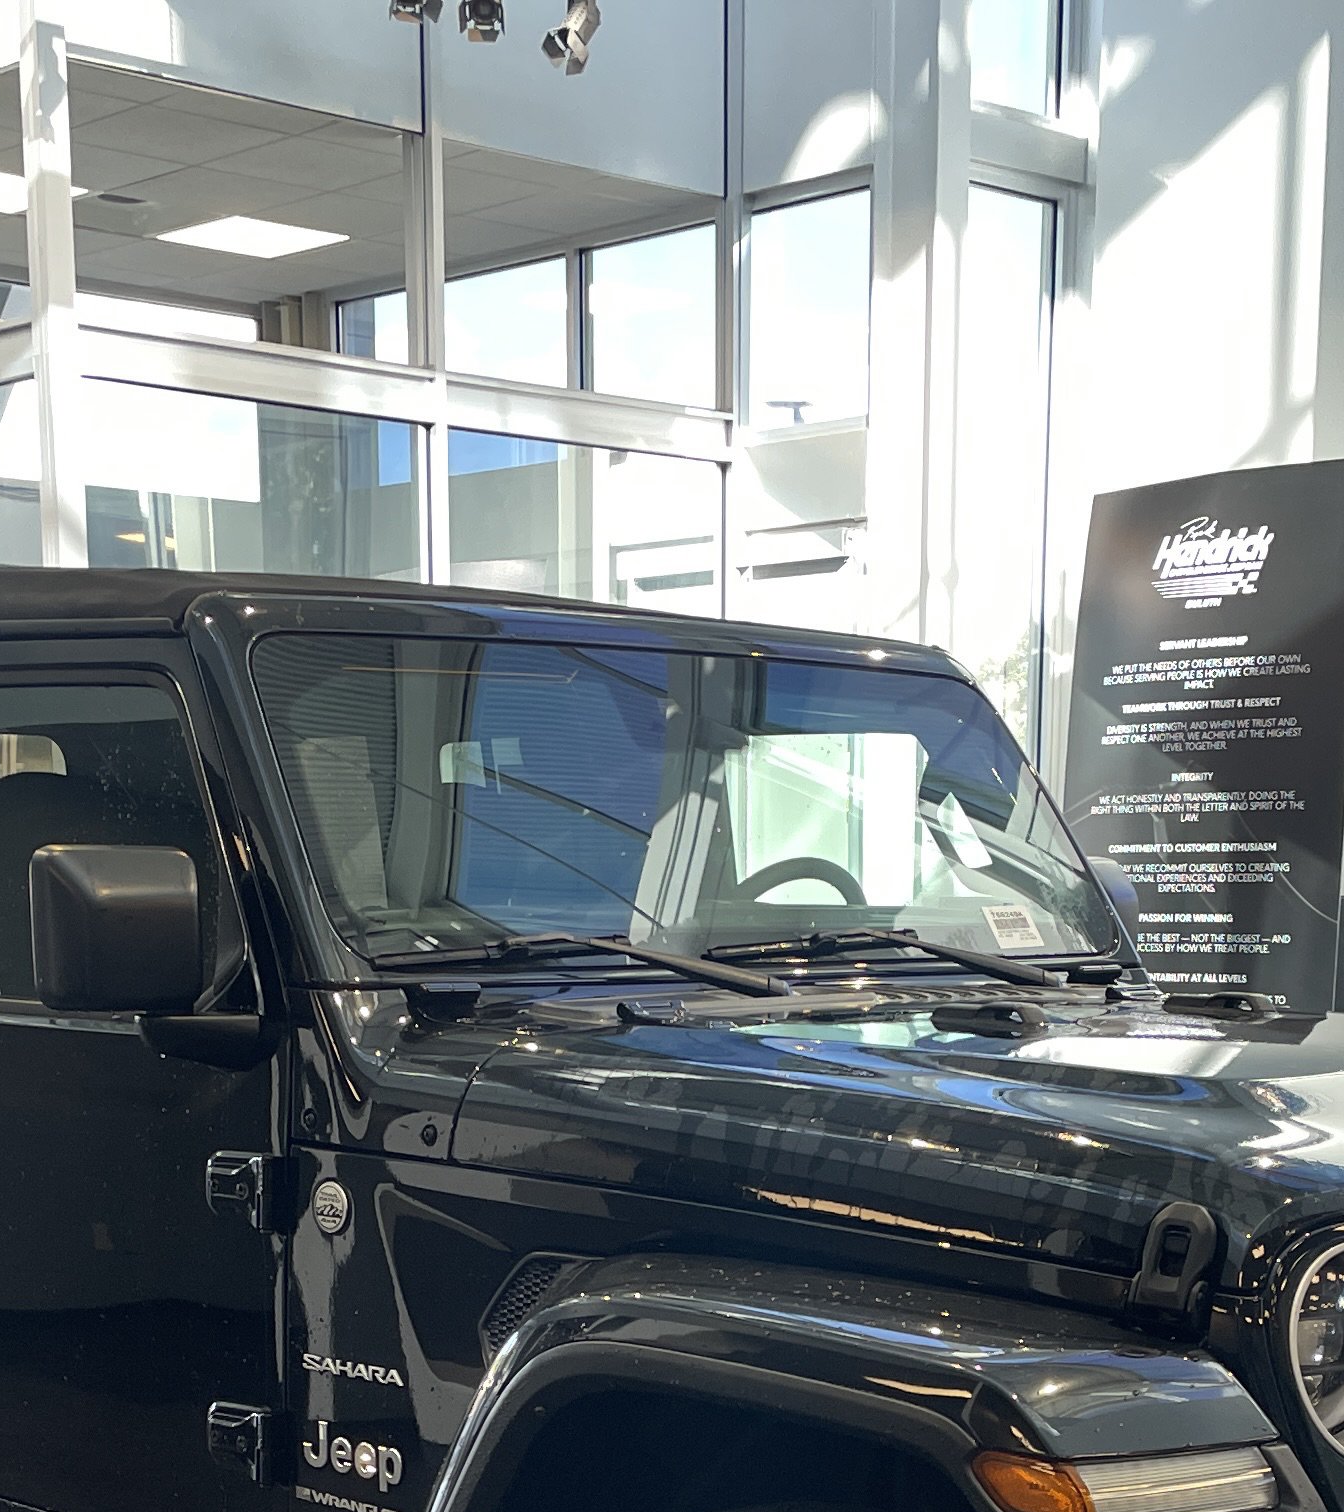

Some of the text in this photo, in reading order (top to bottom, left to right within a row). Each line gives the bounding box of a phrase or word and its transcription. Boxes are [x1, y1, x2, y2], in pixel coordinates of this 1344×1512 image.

[1152, 525, 1275, 579] Hendrick
[1112, 654, 1301, 674] WE PUT THE NEEDS OF OTHERS BEFORE OUR OWN
[1103, 675, 1134, 686] BECAUSE
[1134, 673, 1166, 684] SERVING
[1167, 670, 1195, 681] PEOPLE
[1205, 668, 1228, 679] HOW
[1228, 668, 1242, 677] WE
[1243, 665, 1275, 676] CREATE
[1275, 664, 1311, 675] LASTING
[1122, 702, 1167, 714] TEAMWORK
[1167, 700, 1209, 712] THROUGH
[1210, 698, 1236, 709] TRUST
[1244, 696, 1282, 707] RESPECT
[1106, 724, 1140, 735] DIVERSITY
[1189, 720, 1208, 730] AND
[1209, 719, 1235, 729] WHEN
[1236, 719, 1250, 728] WE
[1252, 717, 1277, 728] TRUST
[1278, 717, 1297, 726] AND
[1101, 735, 1130, 745] RESPECT
[1131, 733, 1147, 744] ONE
[1187, 731, 1200, 741] WE
[1201, 730, 1237, 740] ACHIEVE
[1237, 729, 1248, 739] AT
[1250, 729, 1265, 739] THE
[1266, 727, 1302, 738] HIGHEST
[1162, 743, 1183, 753] LEVEL
[1171, 772, 1214, 782] INTEGRITY
[1099, 795, 1111, 805] WE
[1111, 795, 1125, 804] ACT
[1126, 793, 1163, 804] HONESTLY
[1163, 793, 1181, 802] AND
[1249, 791, 1278, 800] DOING
[1280, 790, 1296, 800] THE
[1091, 800, 1306, 815] RIGHT THING WITHIN BOTH THE LETTER AND SPIRIT OF THE
[1108, 842, 1277, 854] COMMITMENT TO CUSTOMER ENTHUSIASM
[1132, 864, 1144, 873] WE
[1145, 863, 1187, 873] RECOMMIT
[1189, 863, 1234, 873] OURSELVES
[1235, 863, 1246, 872] TO
[1248, 862, 1291, 873] CREATING
[1156, 874, 1207, 883] EXPERIENCES
[1207, 873, 1226, 883] AND
[1227, 873, 1274, 882] EXCEEDING
[1138, 913, 1234, 923] PASSION FOR WINNING
[1146, 933, 1161, 942] THE
[1161, 933, 1181, 943] BEST
[1191, 933, 1209, 943] NOT
[1210, 933, 1226, 943] THE
[1227, 934, 1261, 943] BIGGEST
[1272, 934, 1291, 944] AND
[1164, 943, 1175, 953] BY
[1176, 943, 1198, 953] HOW
[1199, 943, 1212, 953] WE
[1213, 943, 1238, 953] TREAT
[1190, 973, 1201, 983] AT
[1202, 973, 1218, 983] ALL
[1219, 974, 1247, 983] LEVELS
[1274, 995, 1286, 1004] TO
[302, 1352, 405, 1387] SAHARA
[302, 1420, 403, 1492] Jeep
